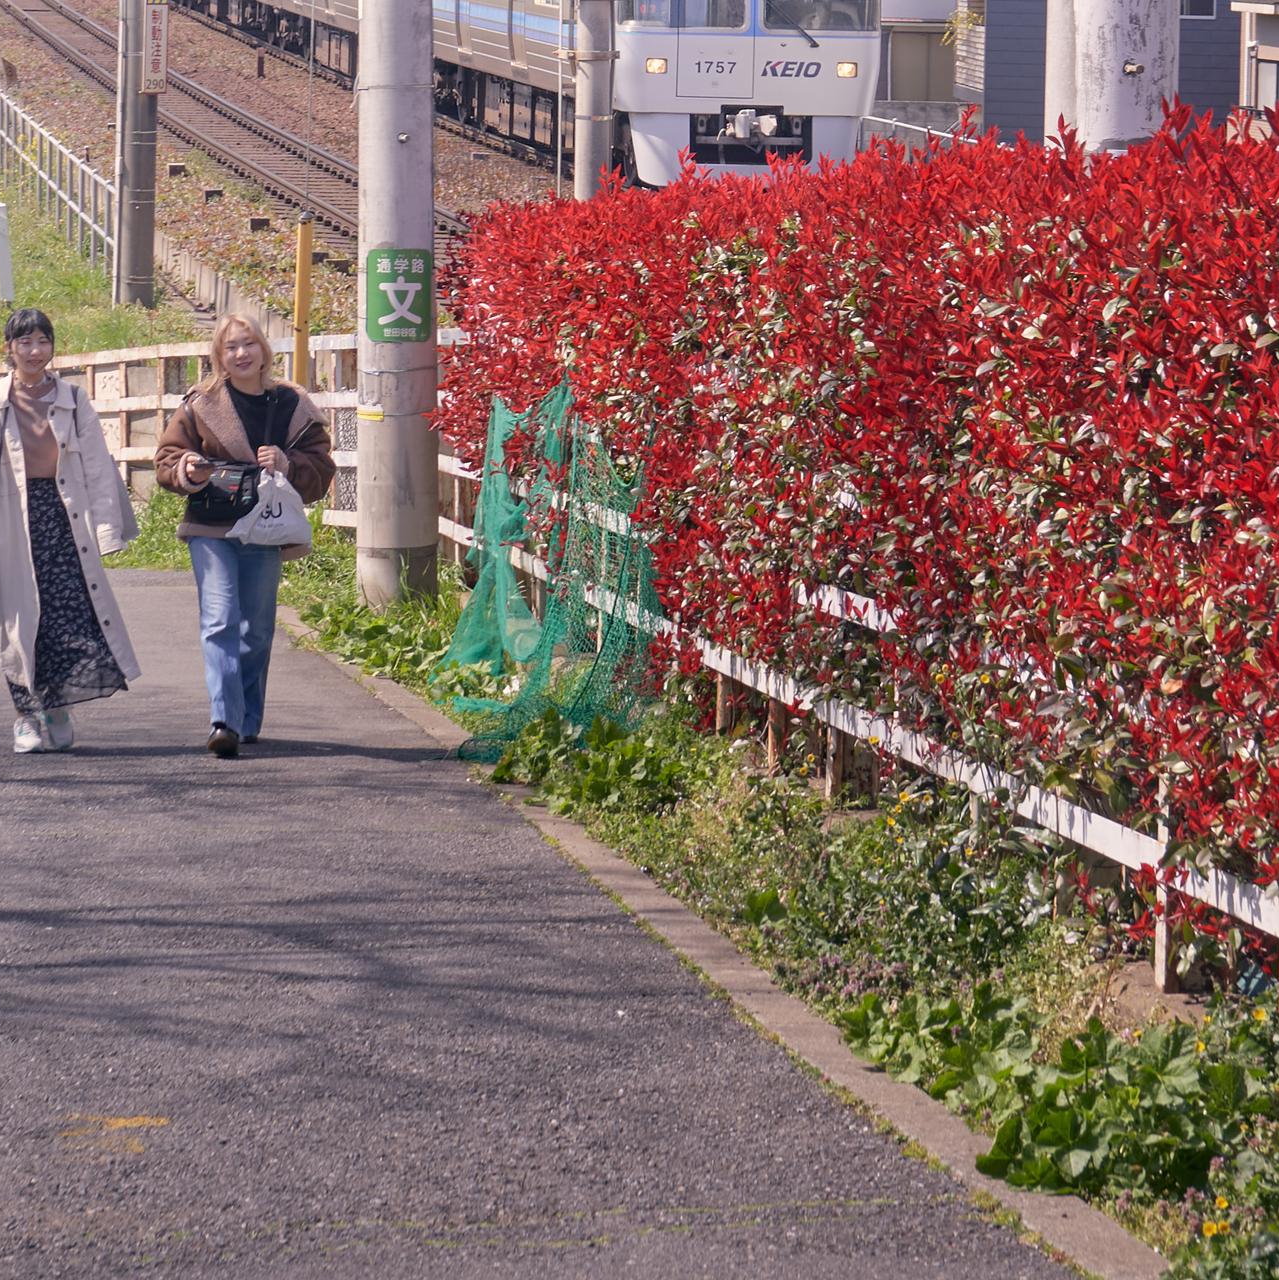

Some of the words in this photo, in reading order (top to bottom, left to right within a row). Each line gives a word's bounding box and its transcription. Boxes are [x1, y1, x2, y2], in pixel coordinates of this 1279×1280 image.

[151, 9, 163, 74] 制動注意
[695, 61, 737, 74] 1757
[761, 61, 822, 78] KEIO
[146, 79, 165, 90] 290
[376, 258, 424, 273] 通学路
[377, 275, 423, 325] 文
[383, 327, 417, 337] 世田谷区
